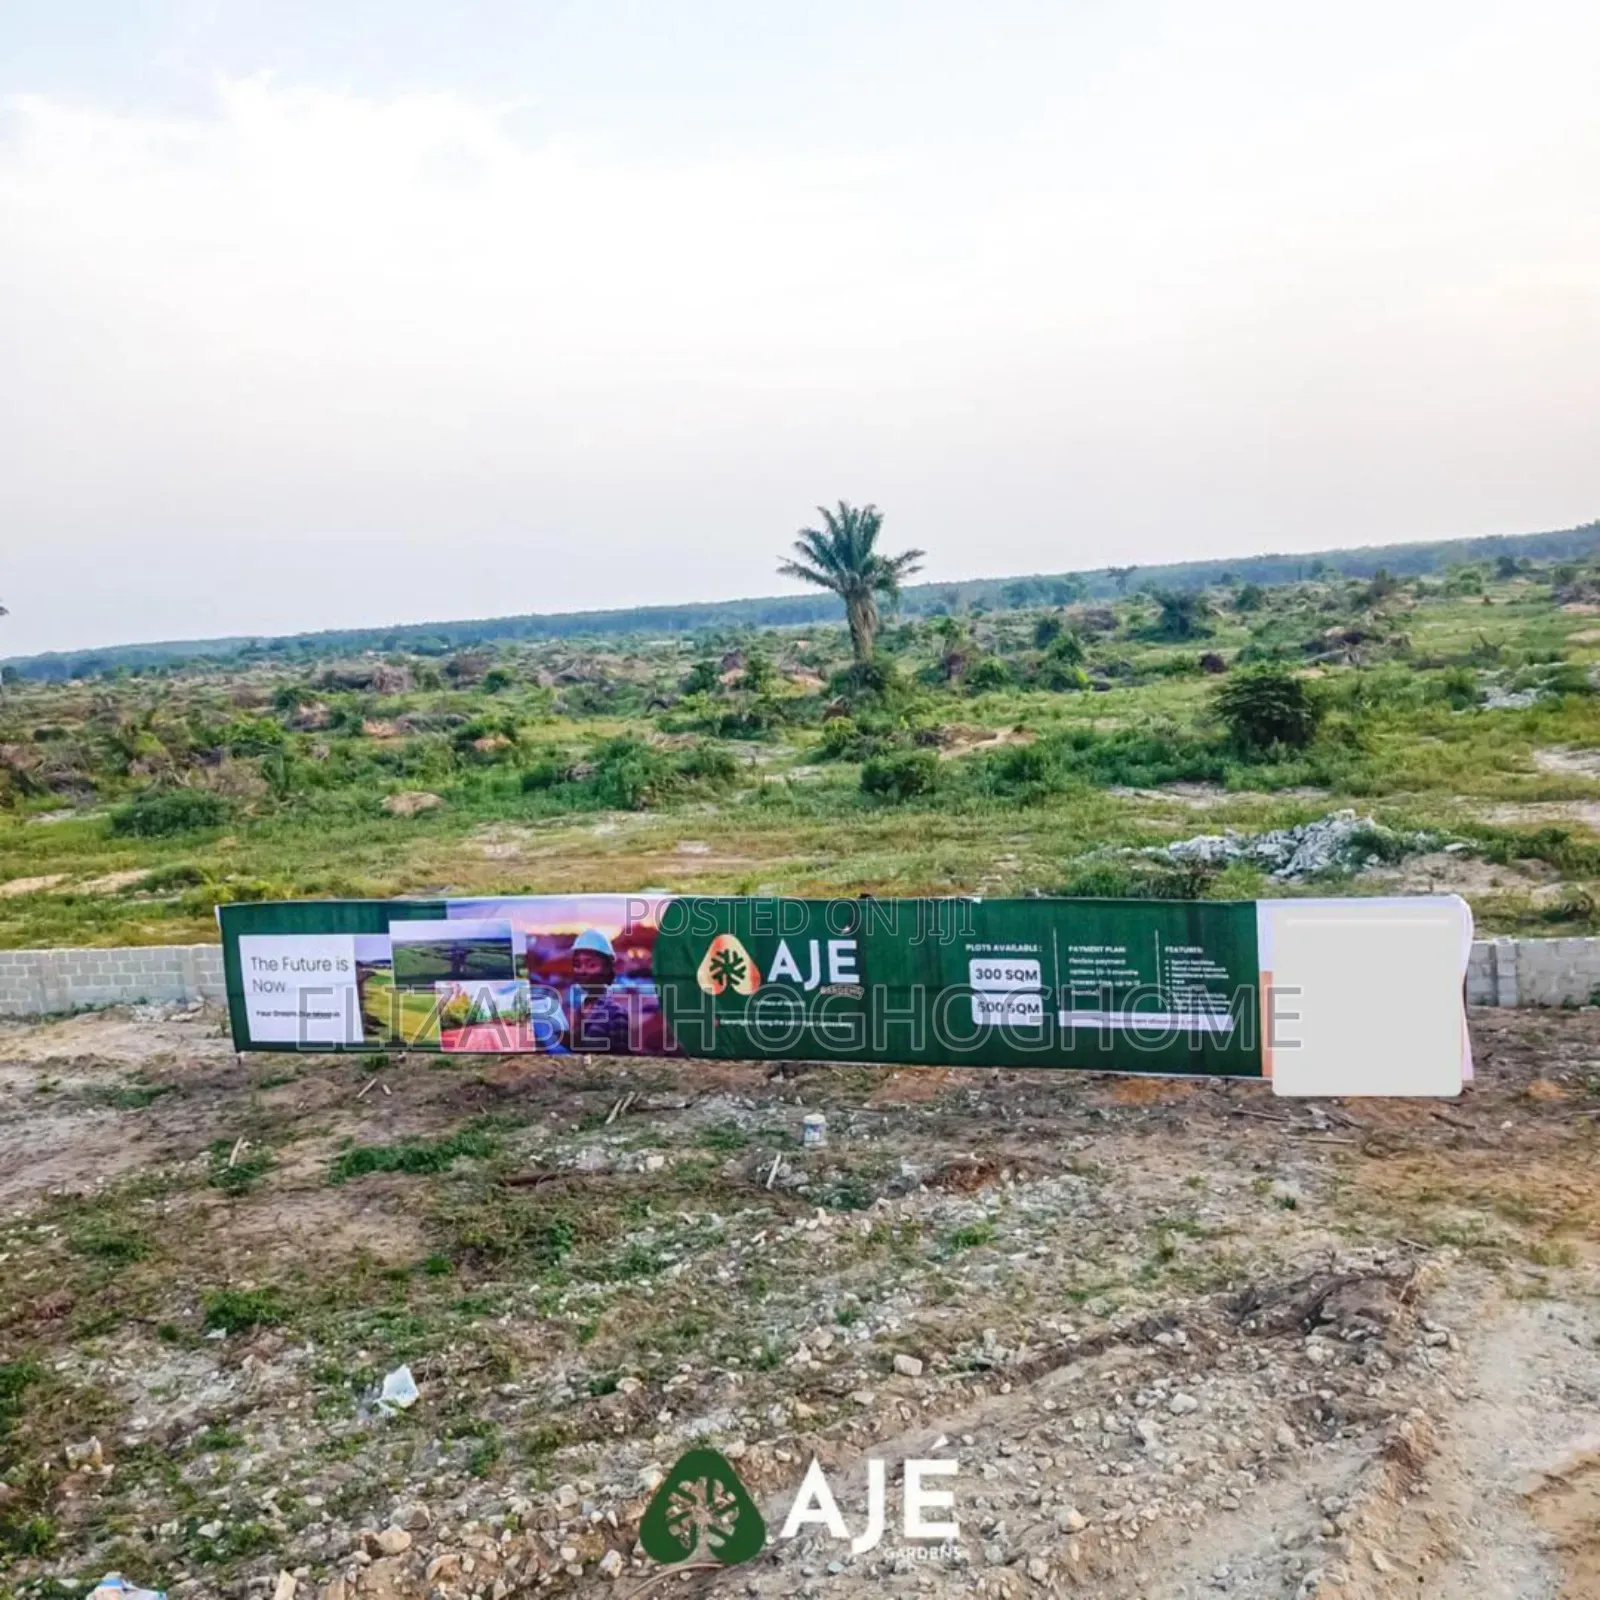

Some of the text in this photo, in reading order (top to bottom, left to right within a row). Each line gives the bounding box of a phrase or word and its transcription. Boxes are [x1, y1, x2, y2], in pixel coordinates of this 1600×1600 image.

[965, 944, 992, 952] PLOTS
[1068, 945, 1104, 953] PAYMENT
[250, 956, 349, 972] The Future is
[975, 968, 1038, 981] 300 SQM
[252, 979, 286, 993] Now
[978, 1001, 1039, 1015] 500 SQM
